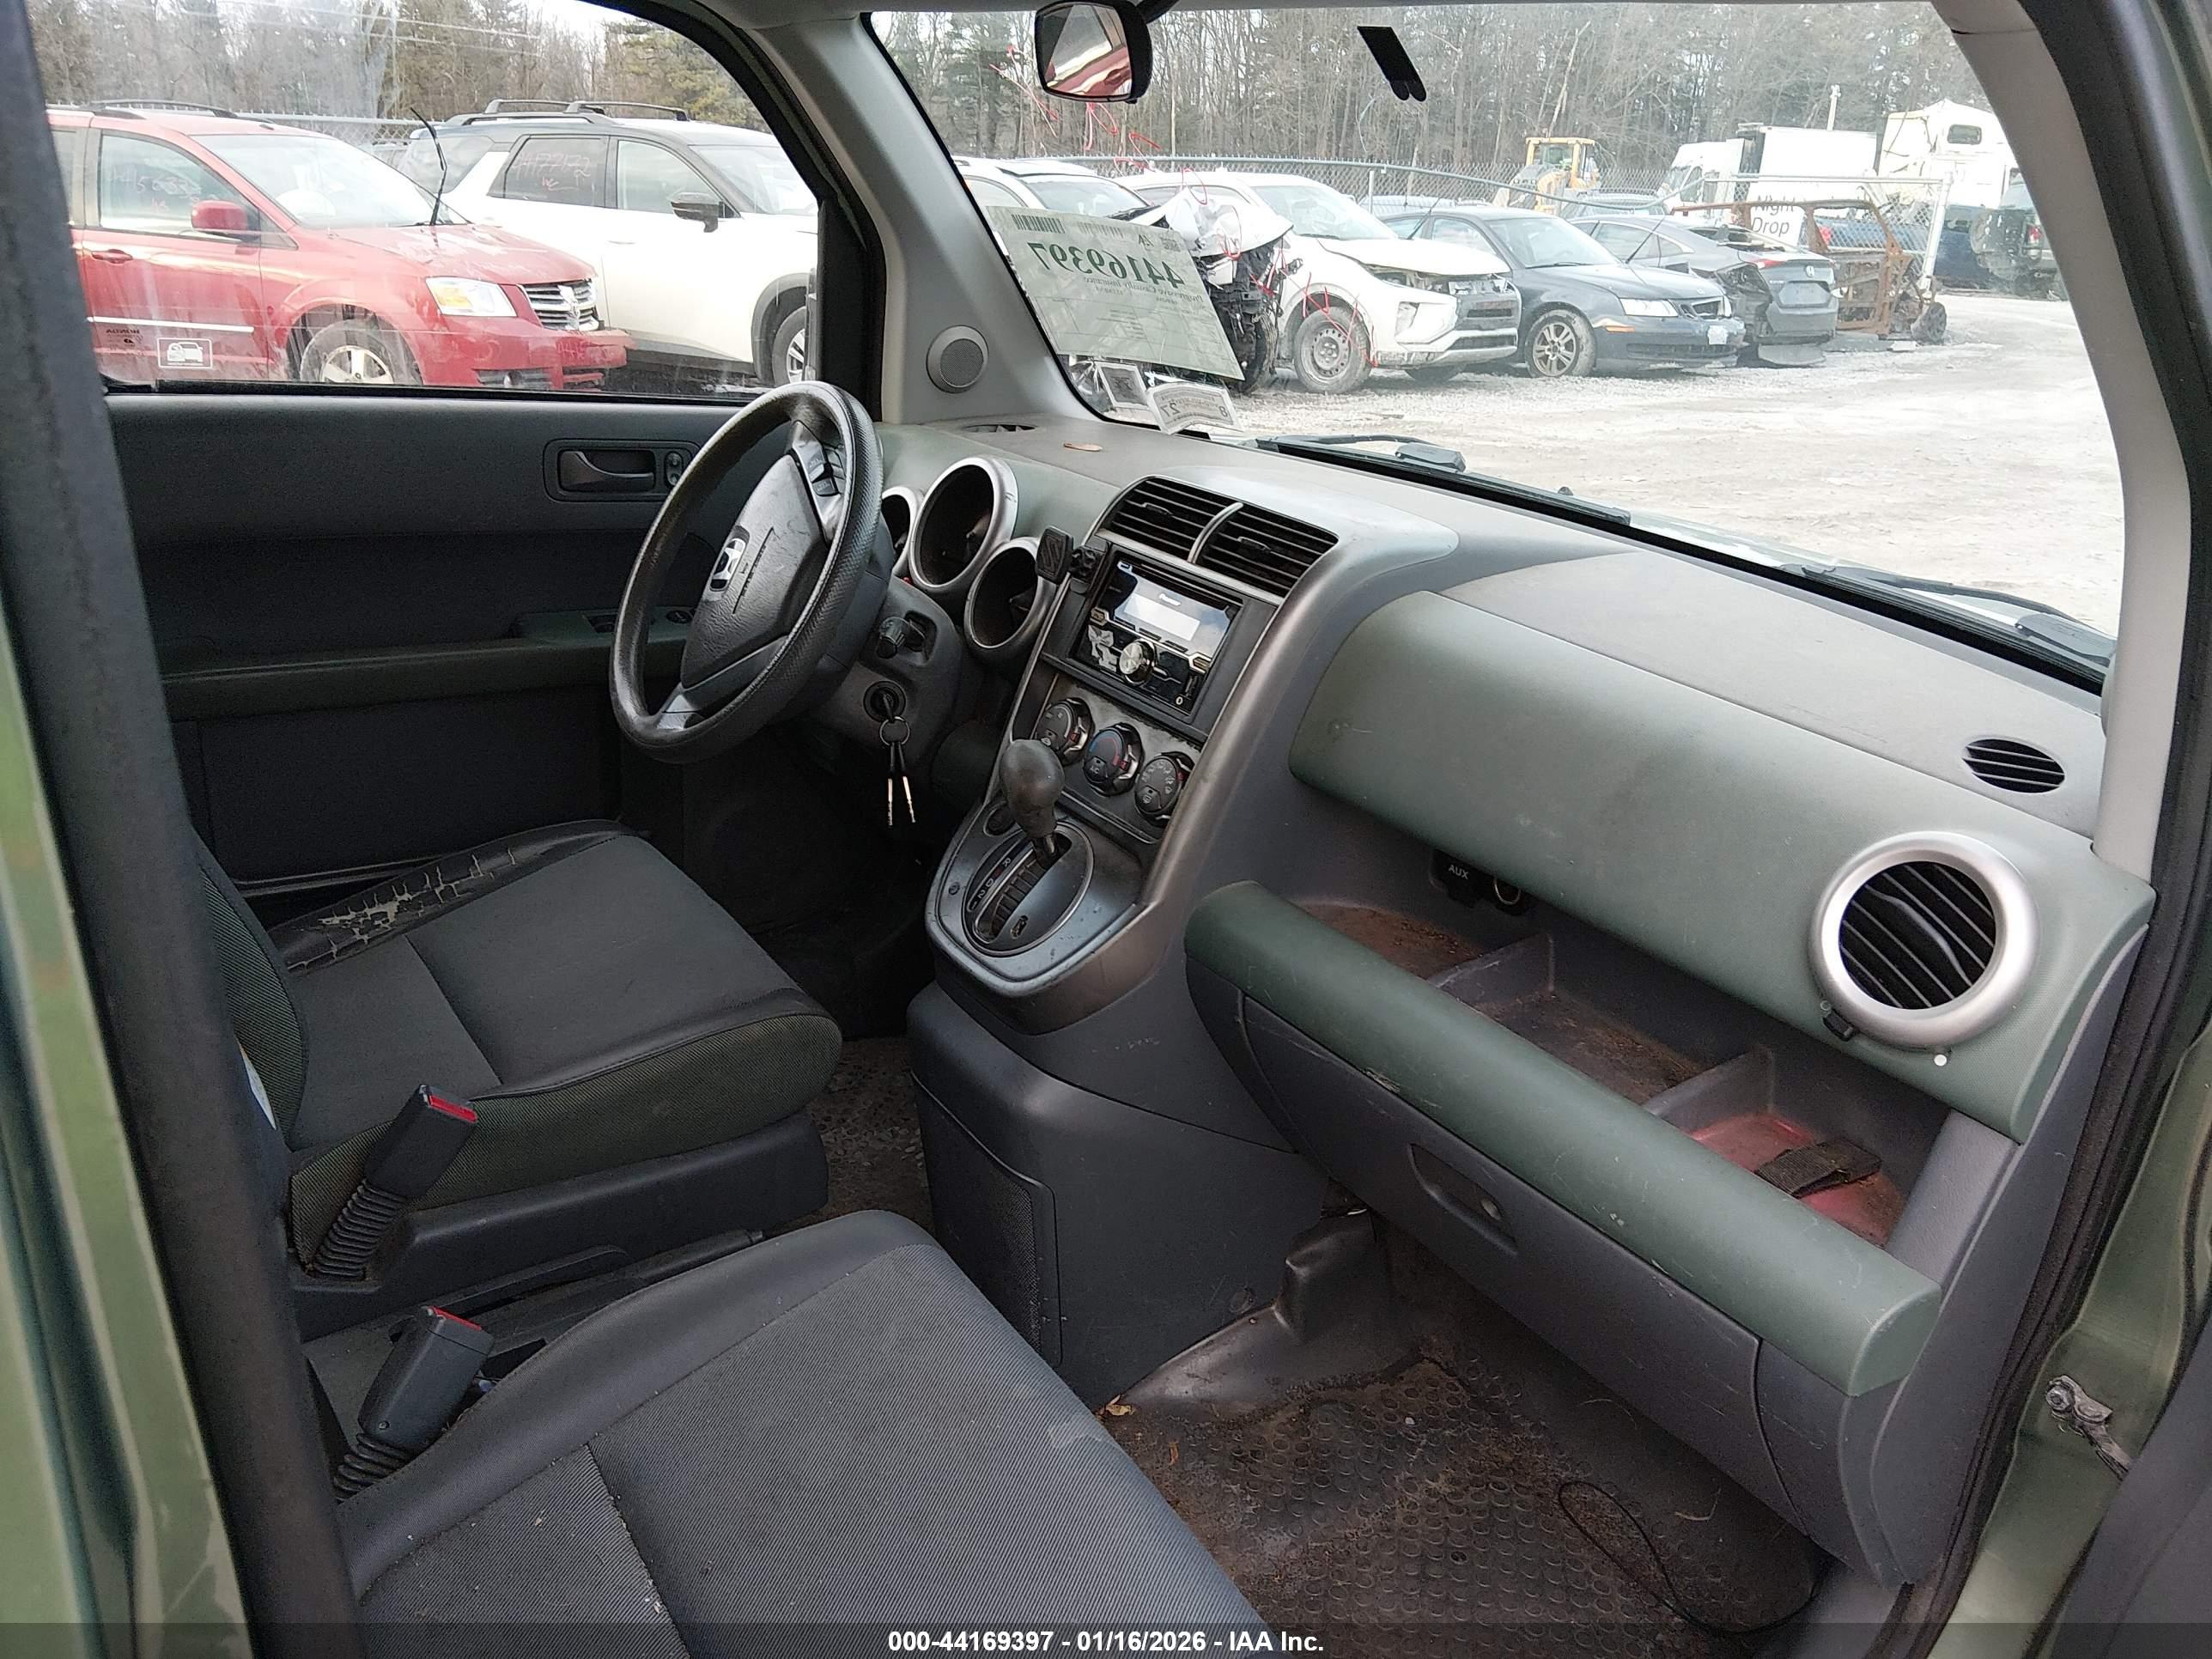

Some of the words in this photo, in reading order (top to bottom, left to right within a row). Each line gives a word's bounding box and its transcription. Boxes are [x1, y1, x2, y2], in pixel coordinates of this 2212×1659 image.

[1753, 216, 1790, 237] Drop
[1001, 857, 1012, 867] R
[1448, 864, 1470, 880] AUX
[985, 878, 994, 888] D
[977, 890, 986, 899] 2
